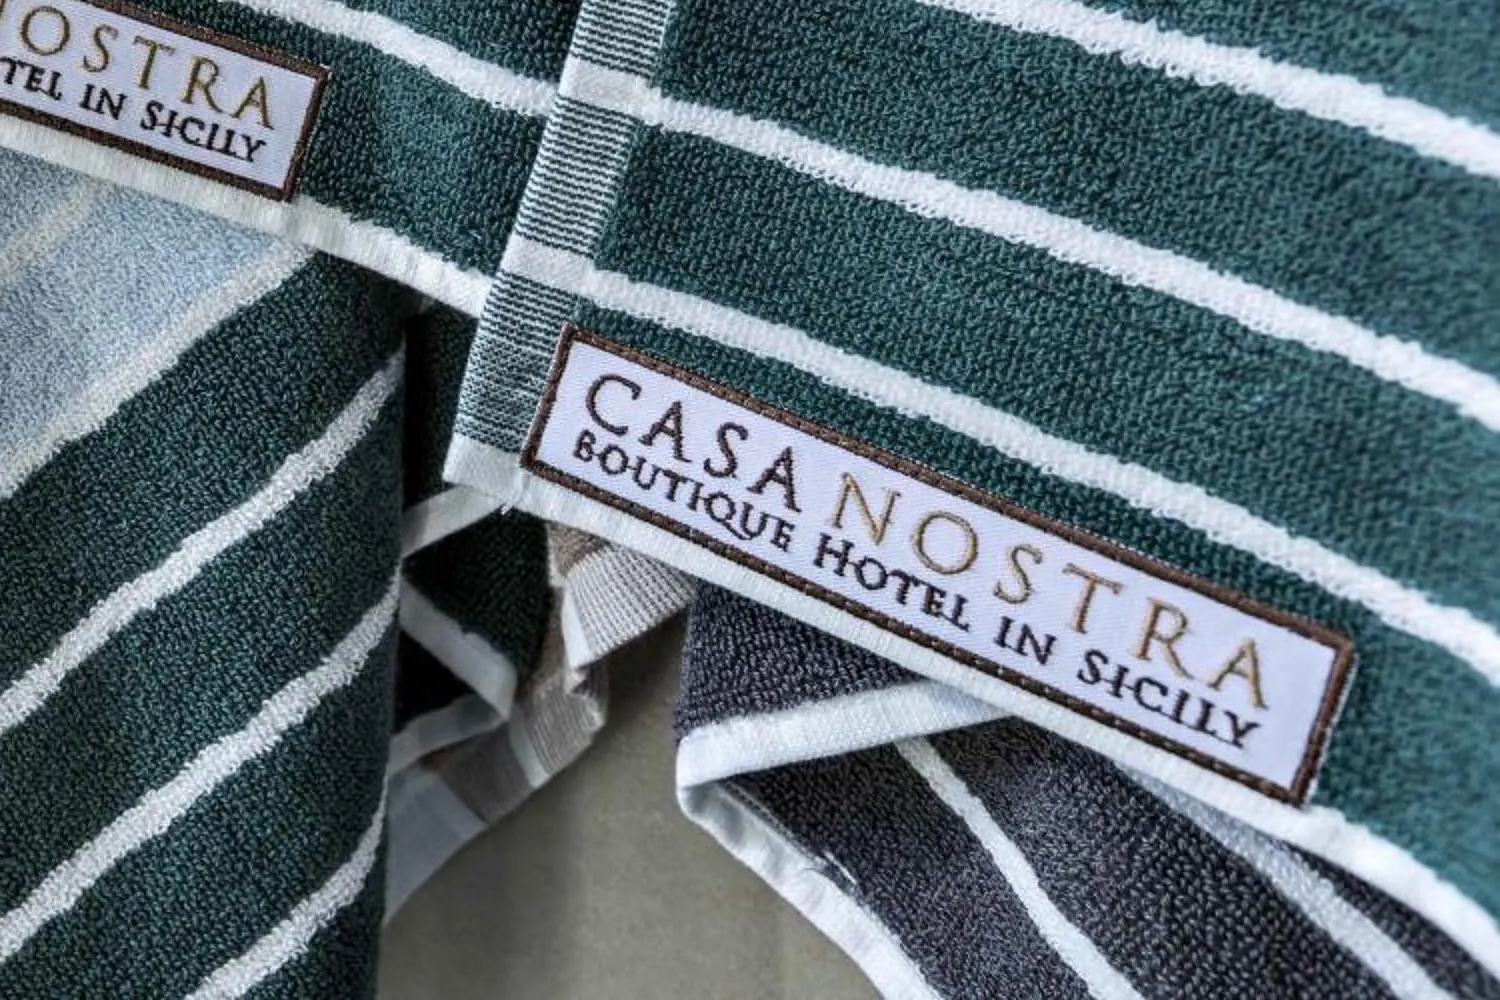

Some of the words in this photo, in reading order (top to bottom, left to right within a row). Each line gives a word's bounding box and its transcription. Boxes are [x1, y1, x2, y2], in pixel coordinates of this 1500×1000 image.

[79, 83, 128, 122] IN
[140, 101, 269, 163] SICILY
[573, 430, 794, 552] BOUTIQUE
[814, 535, 970, 632] HOTEL
[994, 616, 1056, 666] IN
[1077, 649, 1263, 750] SICILY
[584, 374, 802, 513] CASA
[830, 472, 1271, 710] NOSTRA
